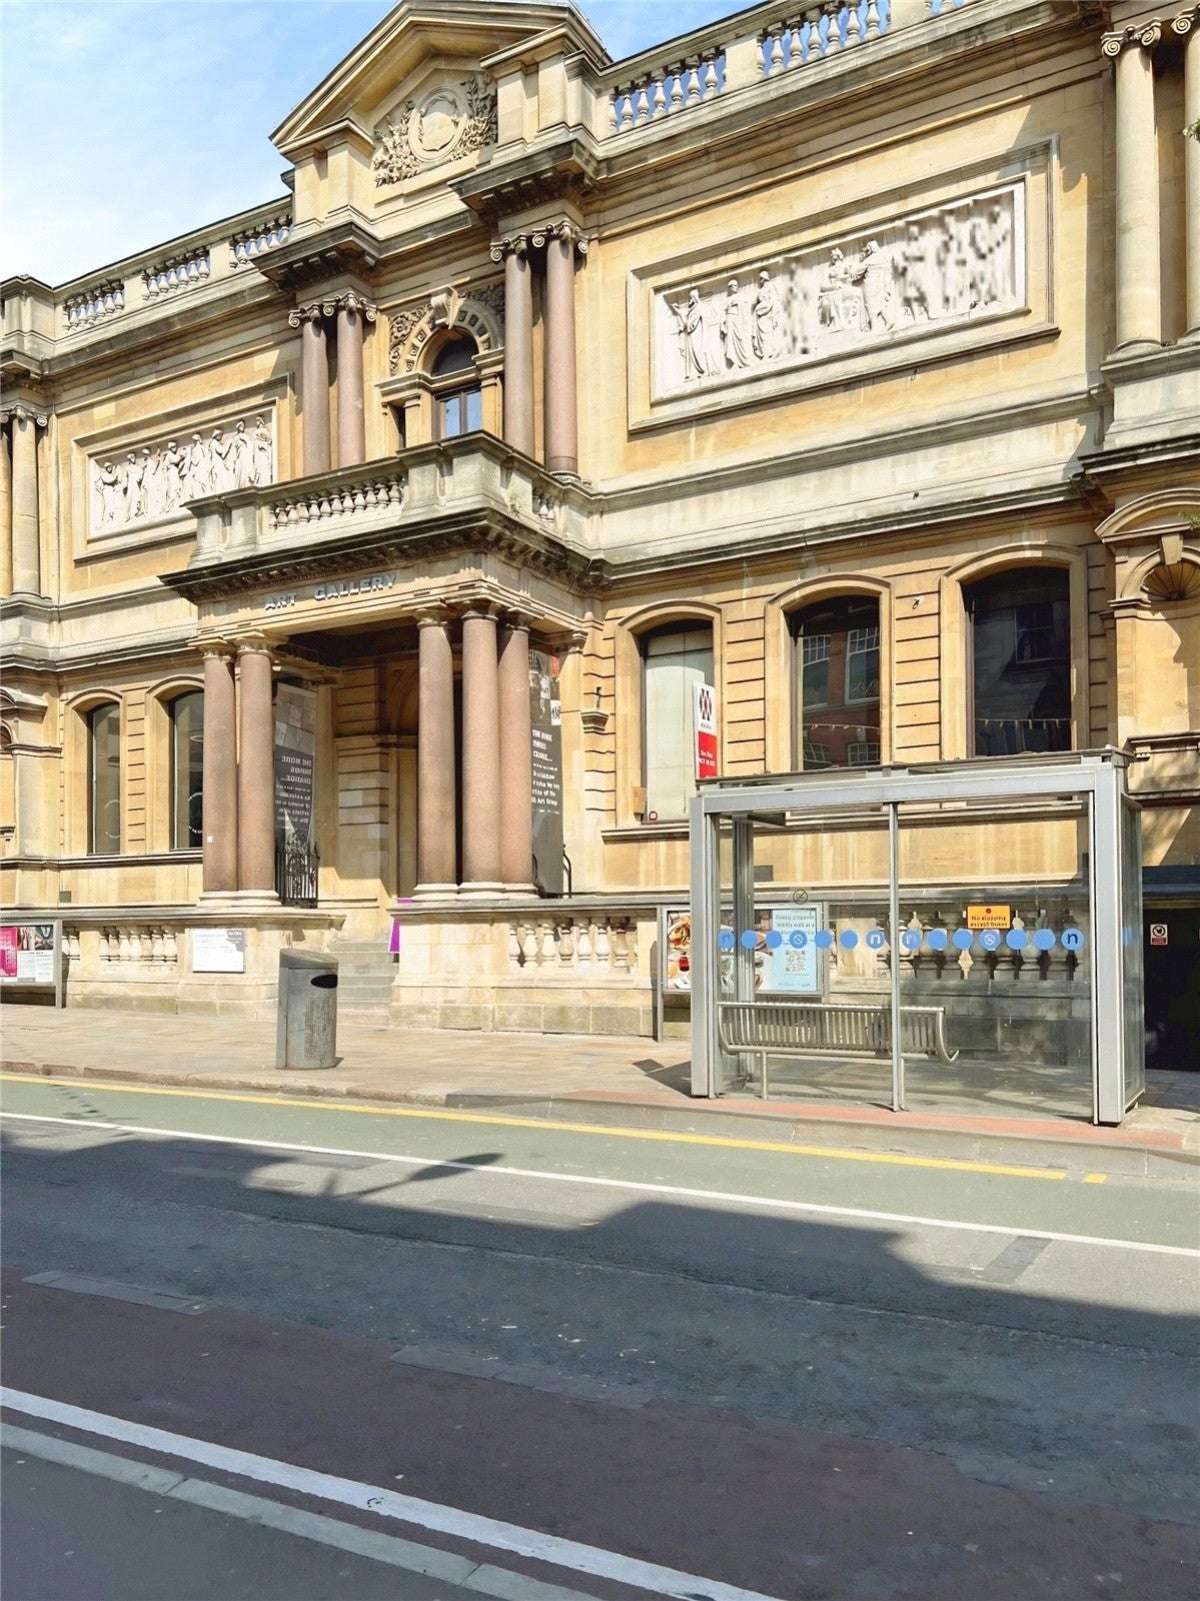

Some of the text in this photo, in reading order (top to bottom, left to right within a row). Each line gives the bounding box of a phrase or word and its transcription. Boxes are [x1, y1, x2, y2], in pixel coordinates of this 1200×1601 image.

[264, 574, 396, 611] ART GALLERY
[870, 933, 881, 945] n
[1066, 933, 1078, 944] n
